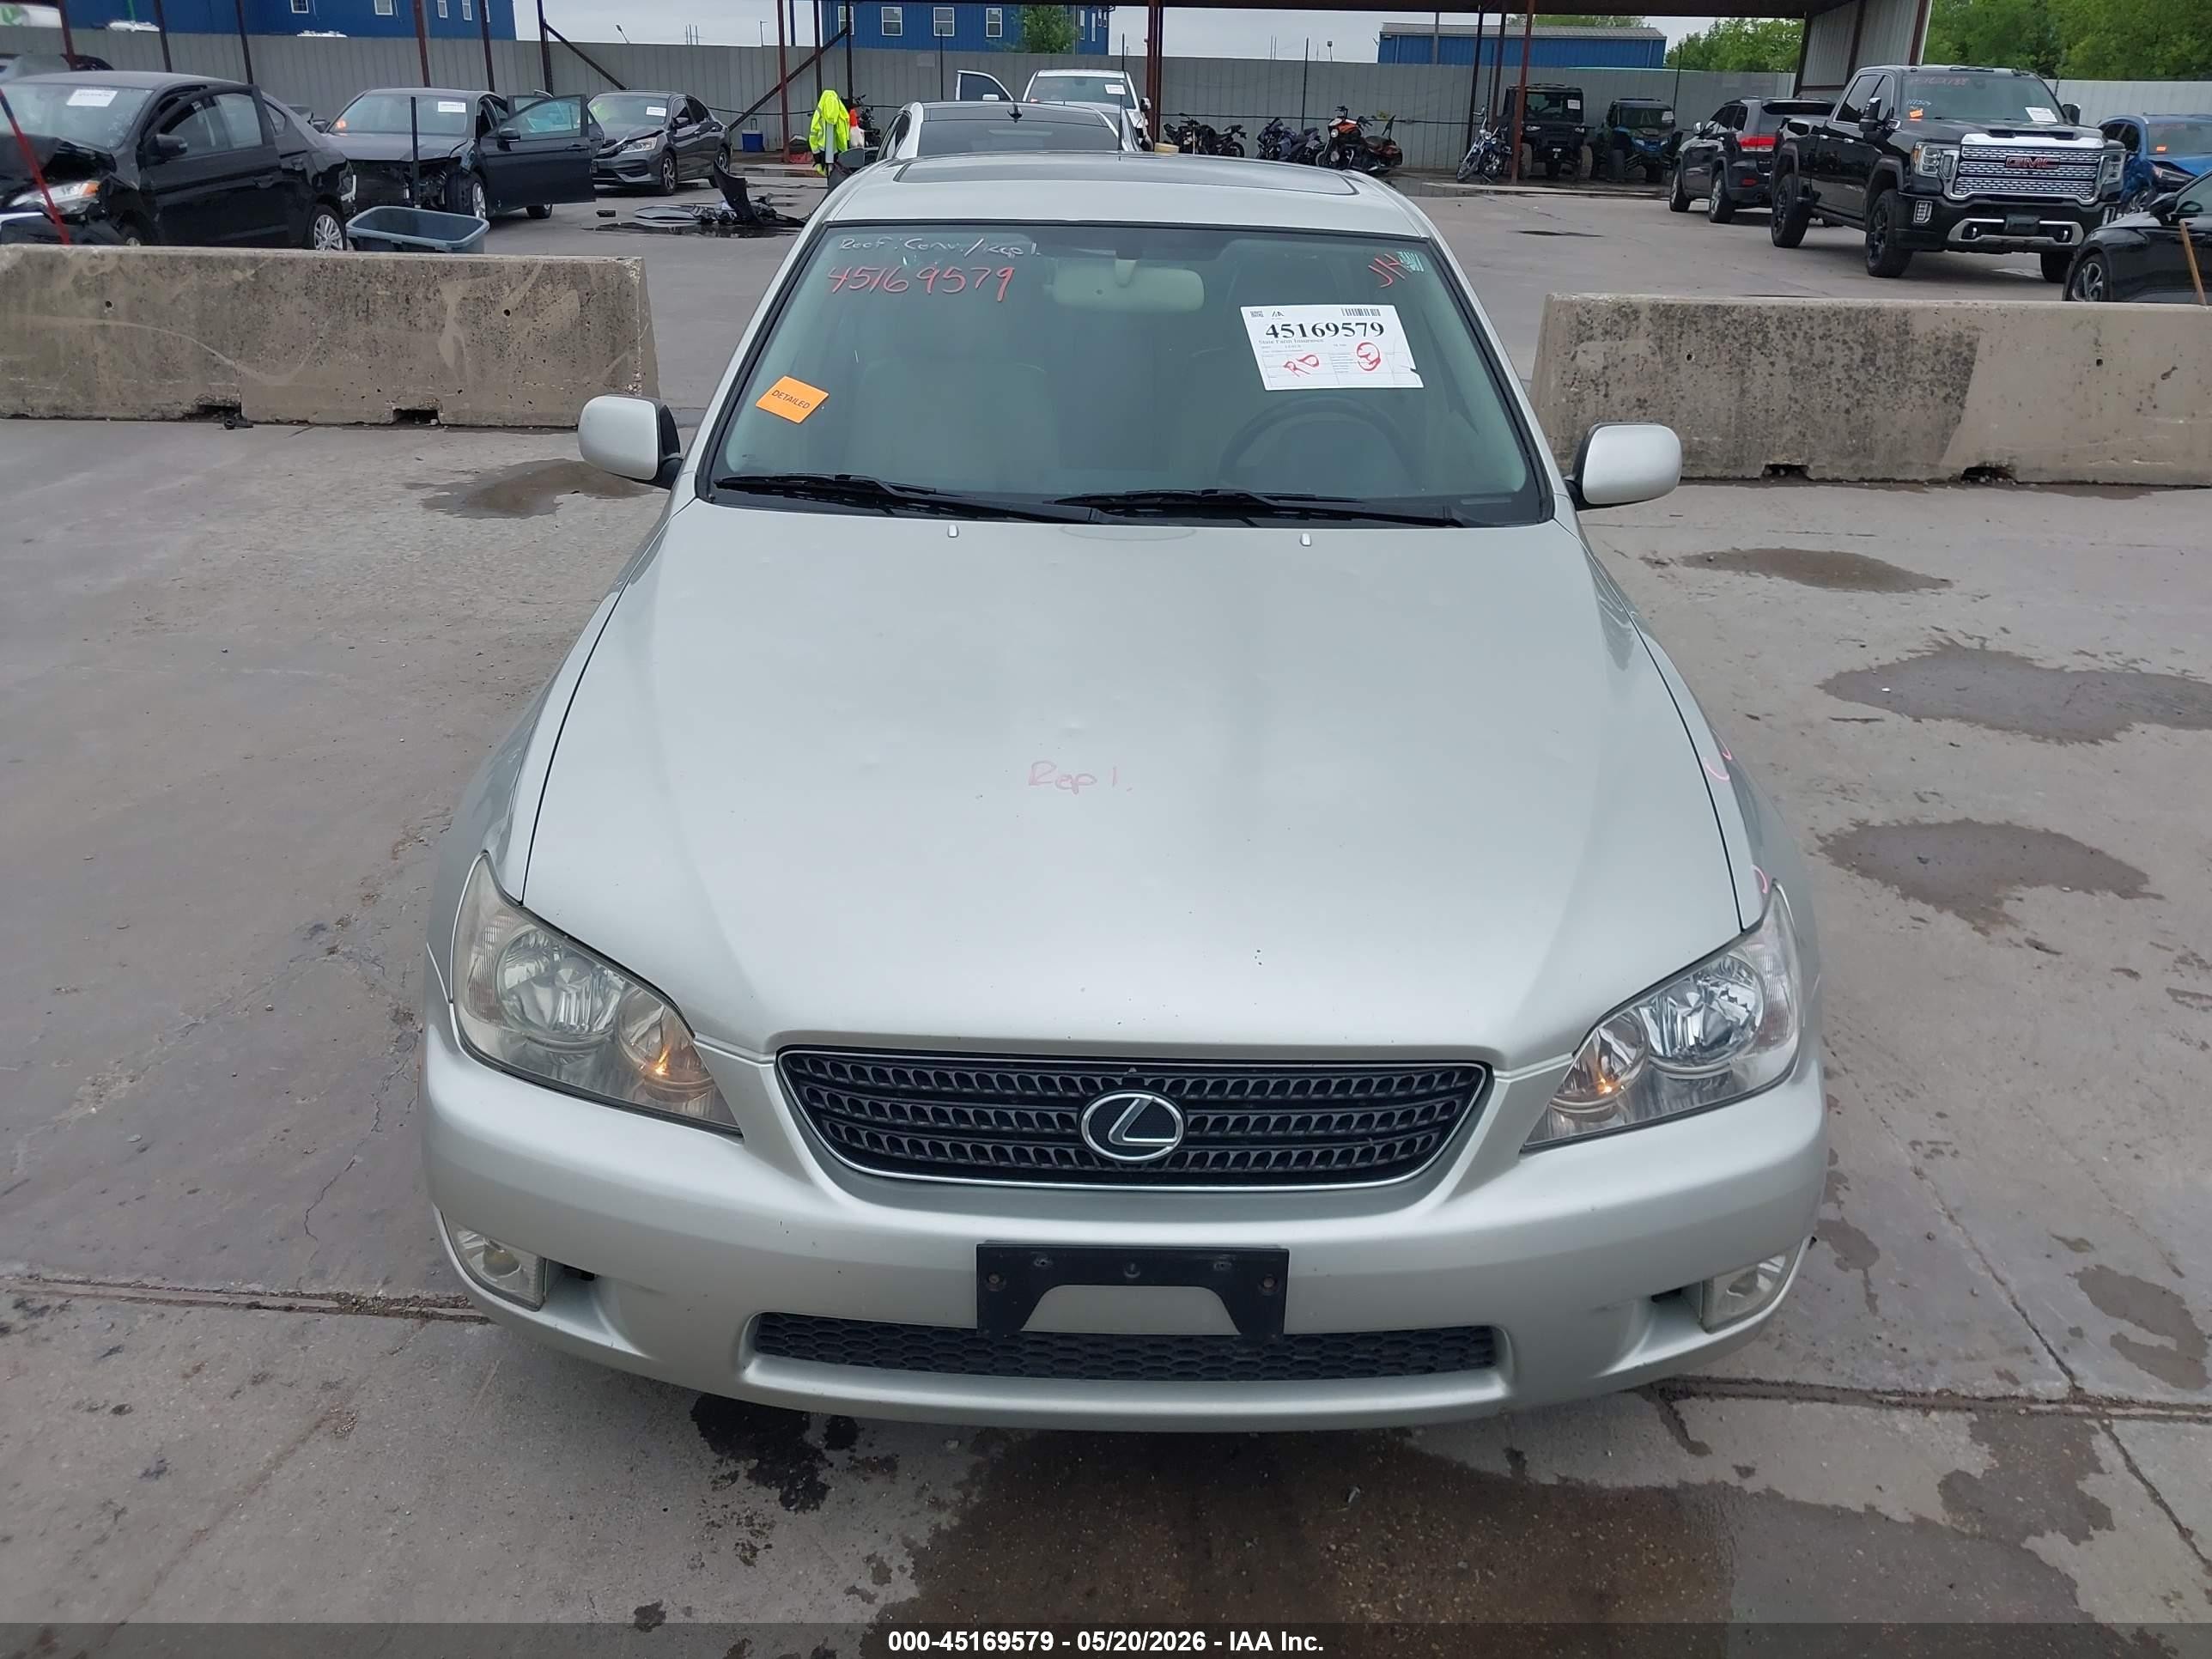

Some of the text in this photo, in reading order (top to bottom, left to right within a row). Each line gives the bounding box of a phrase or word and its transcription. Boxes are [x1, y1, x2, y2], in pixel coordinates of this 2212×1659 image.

[2005, 155, 2060, 169] GMC
[827, 265, 1016, 302] 45169579
[1265, 321, 1385, 338] 45169579
[771, 389, 811, 410] DETAILED
